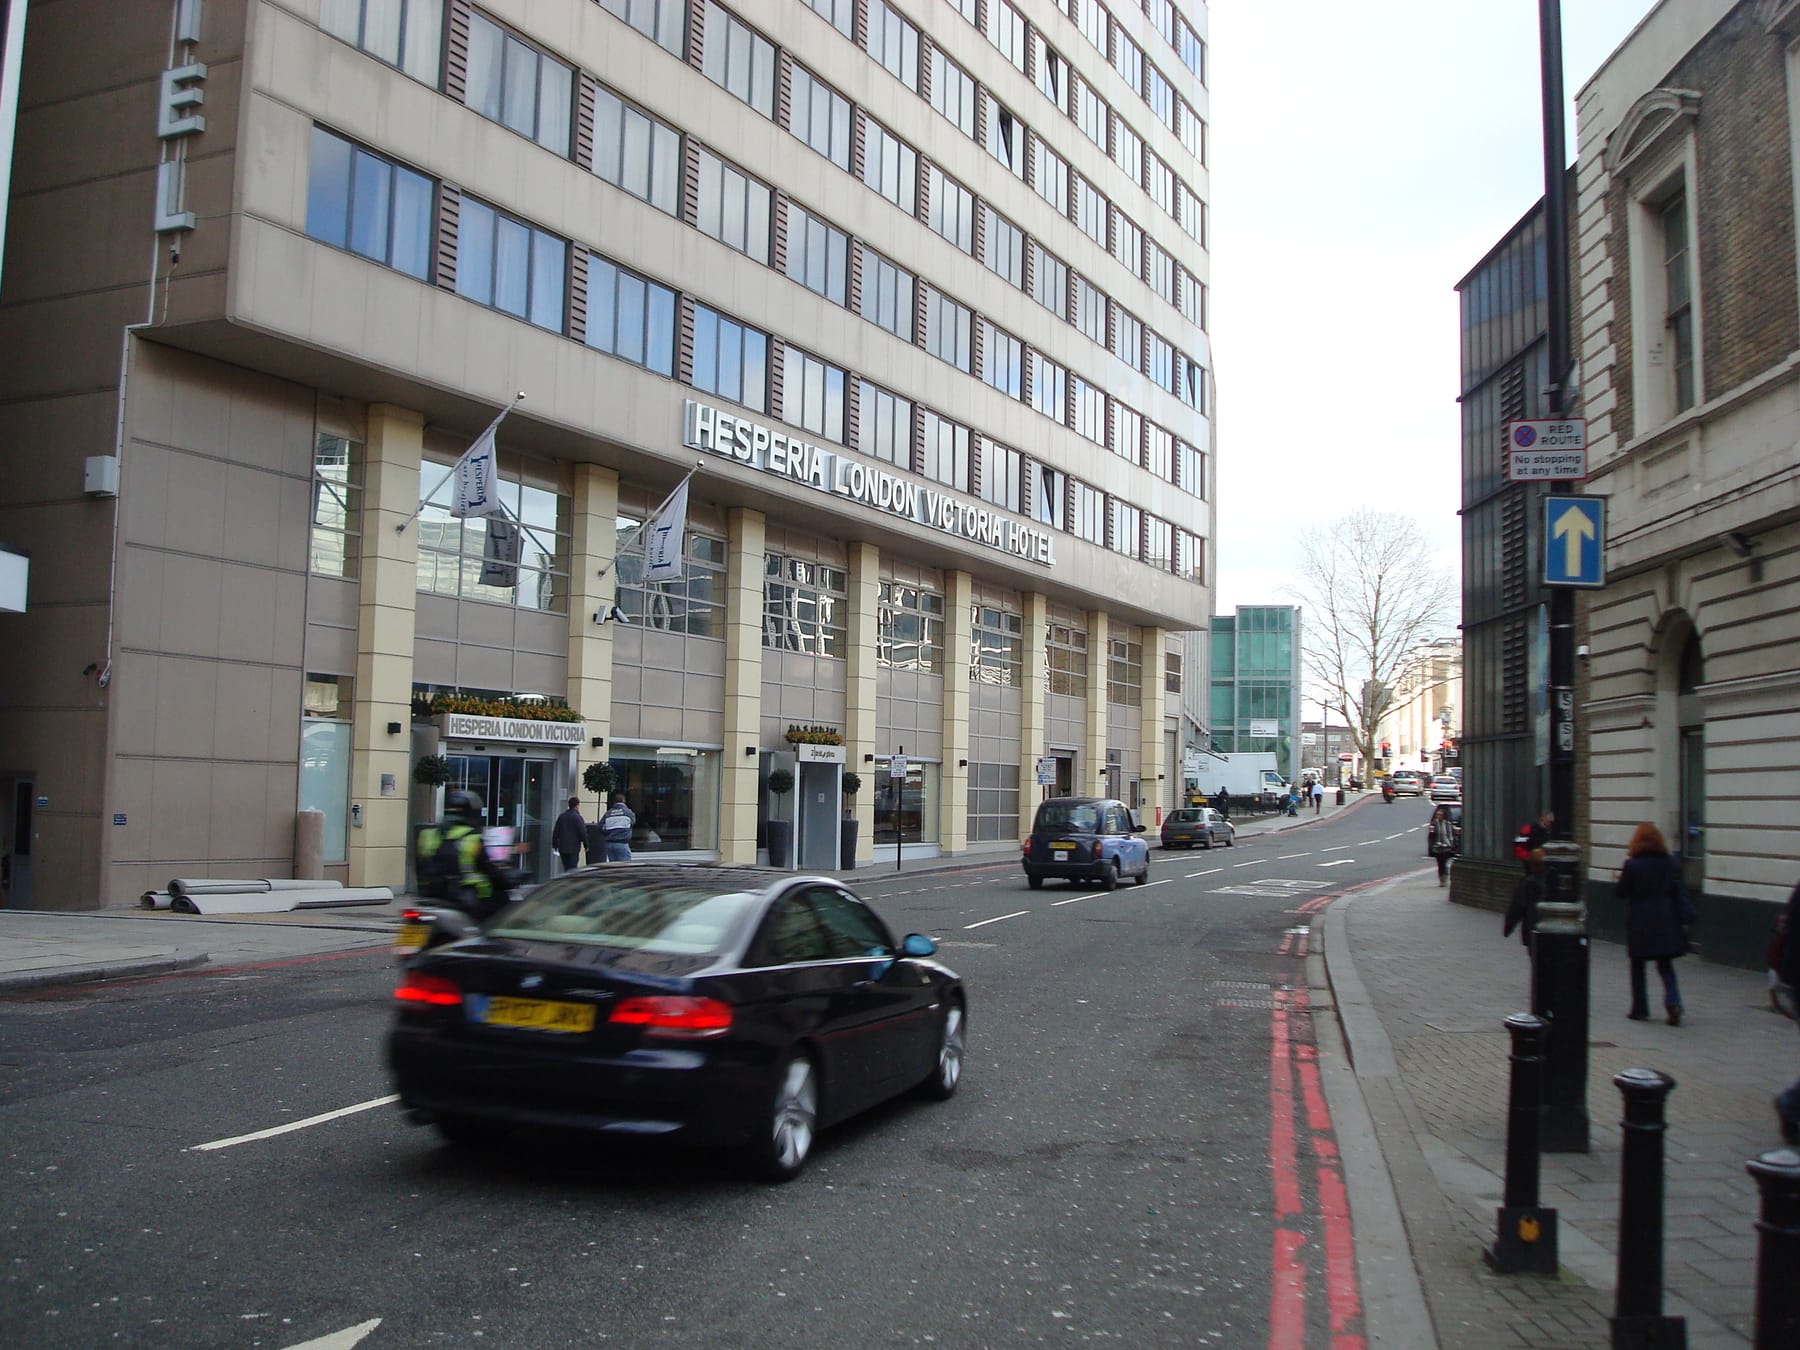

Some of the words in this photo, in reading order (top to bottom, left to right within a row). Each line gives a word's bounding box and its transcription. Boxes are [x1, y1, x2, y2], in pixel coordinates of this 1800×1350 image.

[1549, 425, 1574, 434] RED
[1541, 436, 1582, 445] ROUTE
[1515, 456, 1530, 464] No
[1534, 454, 1582, 464] stopping
[1532, 468, 1551, 476] any
[1555, 466, 1579, 474] time
[690, 402, 826, 488] HESPERIA
[832, 455, 918, 518] LONDON
[923, 489, 1004, 548] VICTORIA
[1007, 520, 1057, 566] HOTEL
[450, 718, 501, 737] HESPERIA
[504, 722, 543, 739] LONDON
[545, 725, 586, 742] VICTORIA
